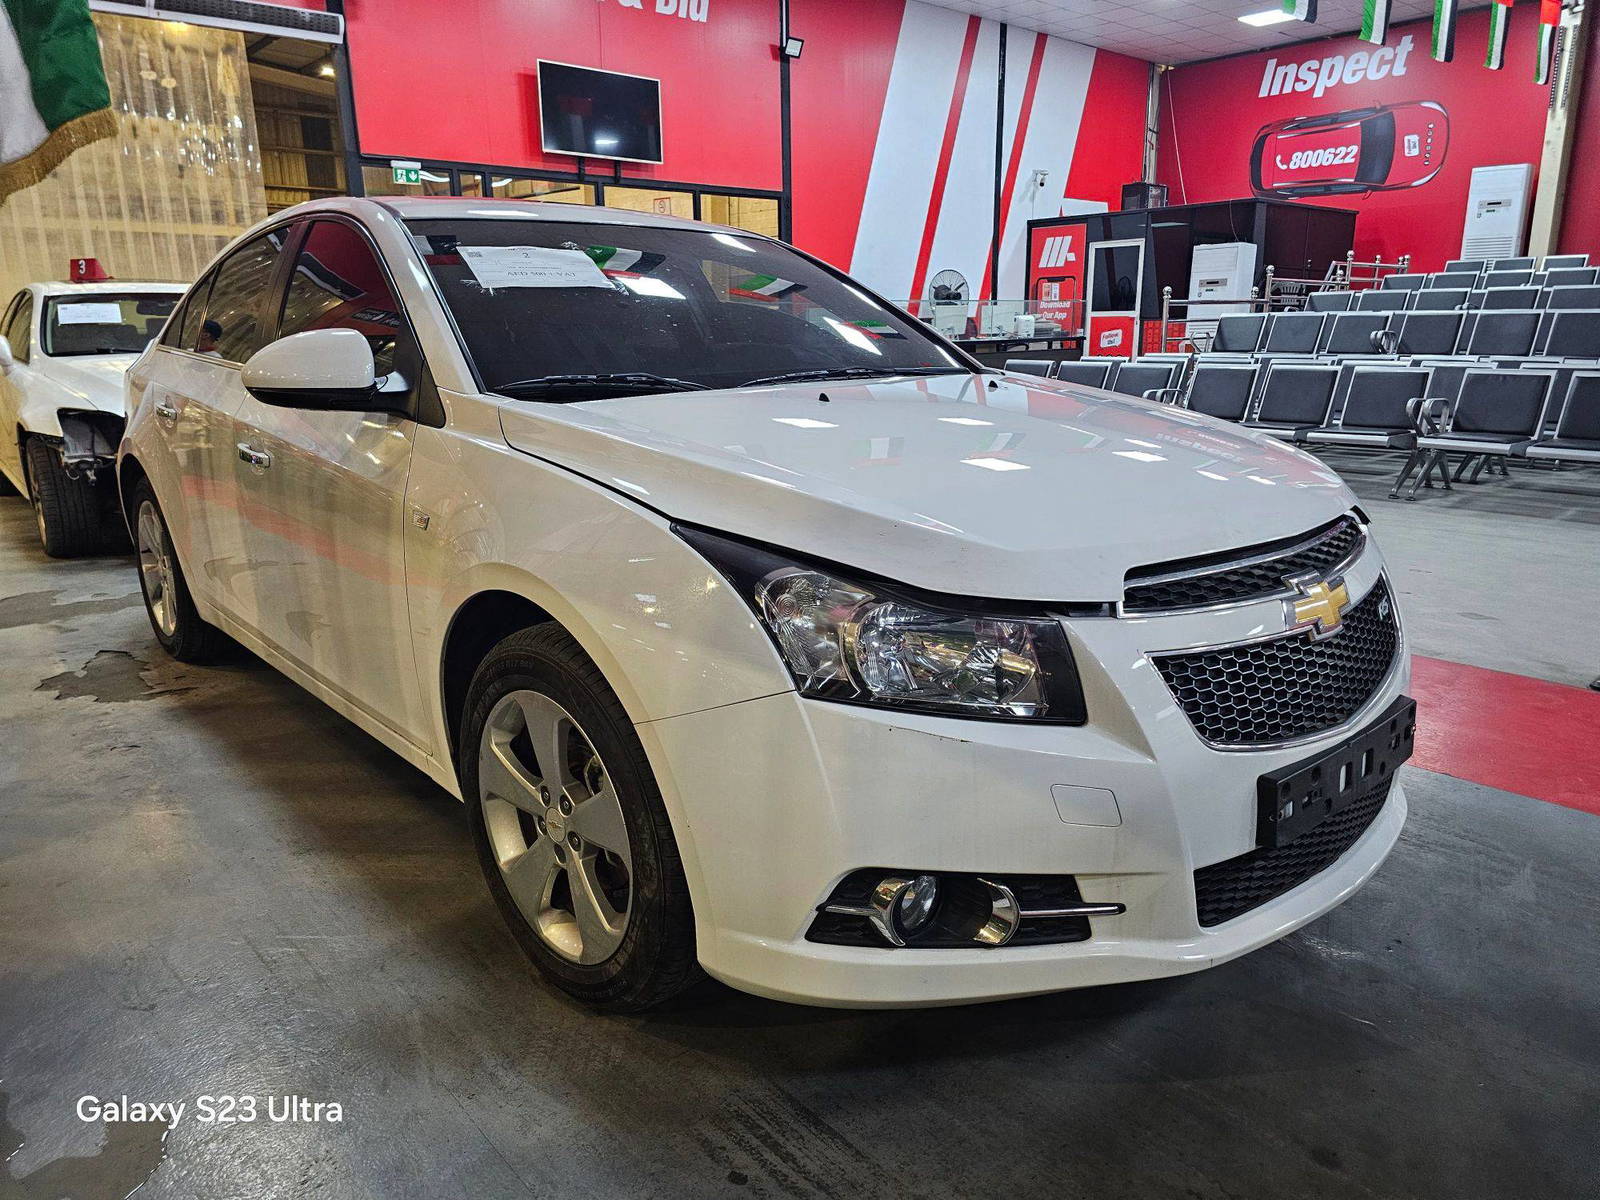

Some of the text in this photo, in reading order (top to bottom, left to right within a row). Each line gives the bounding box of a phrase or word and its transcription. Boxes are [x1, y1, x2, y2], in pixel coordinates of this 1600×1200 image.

[1258, 34, 1414, 98] Inspect
[1288, 144, 1359, 169] 800622
[78, 259, 86, 274] 3
[1040, 301, 1071, 309] Download
[1054, 311, 1067, 320] App
